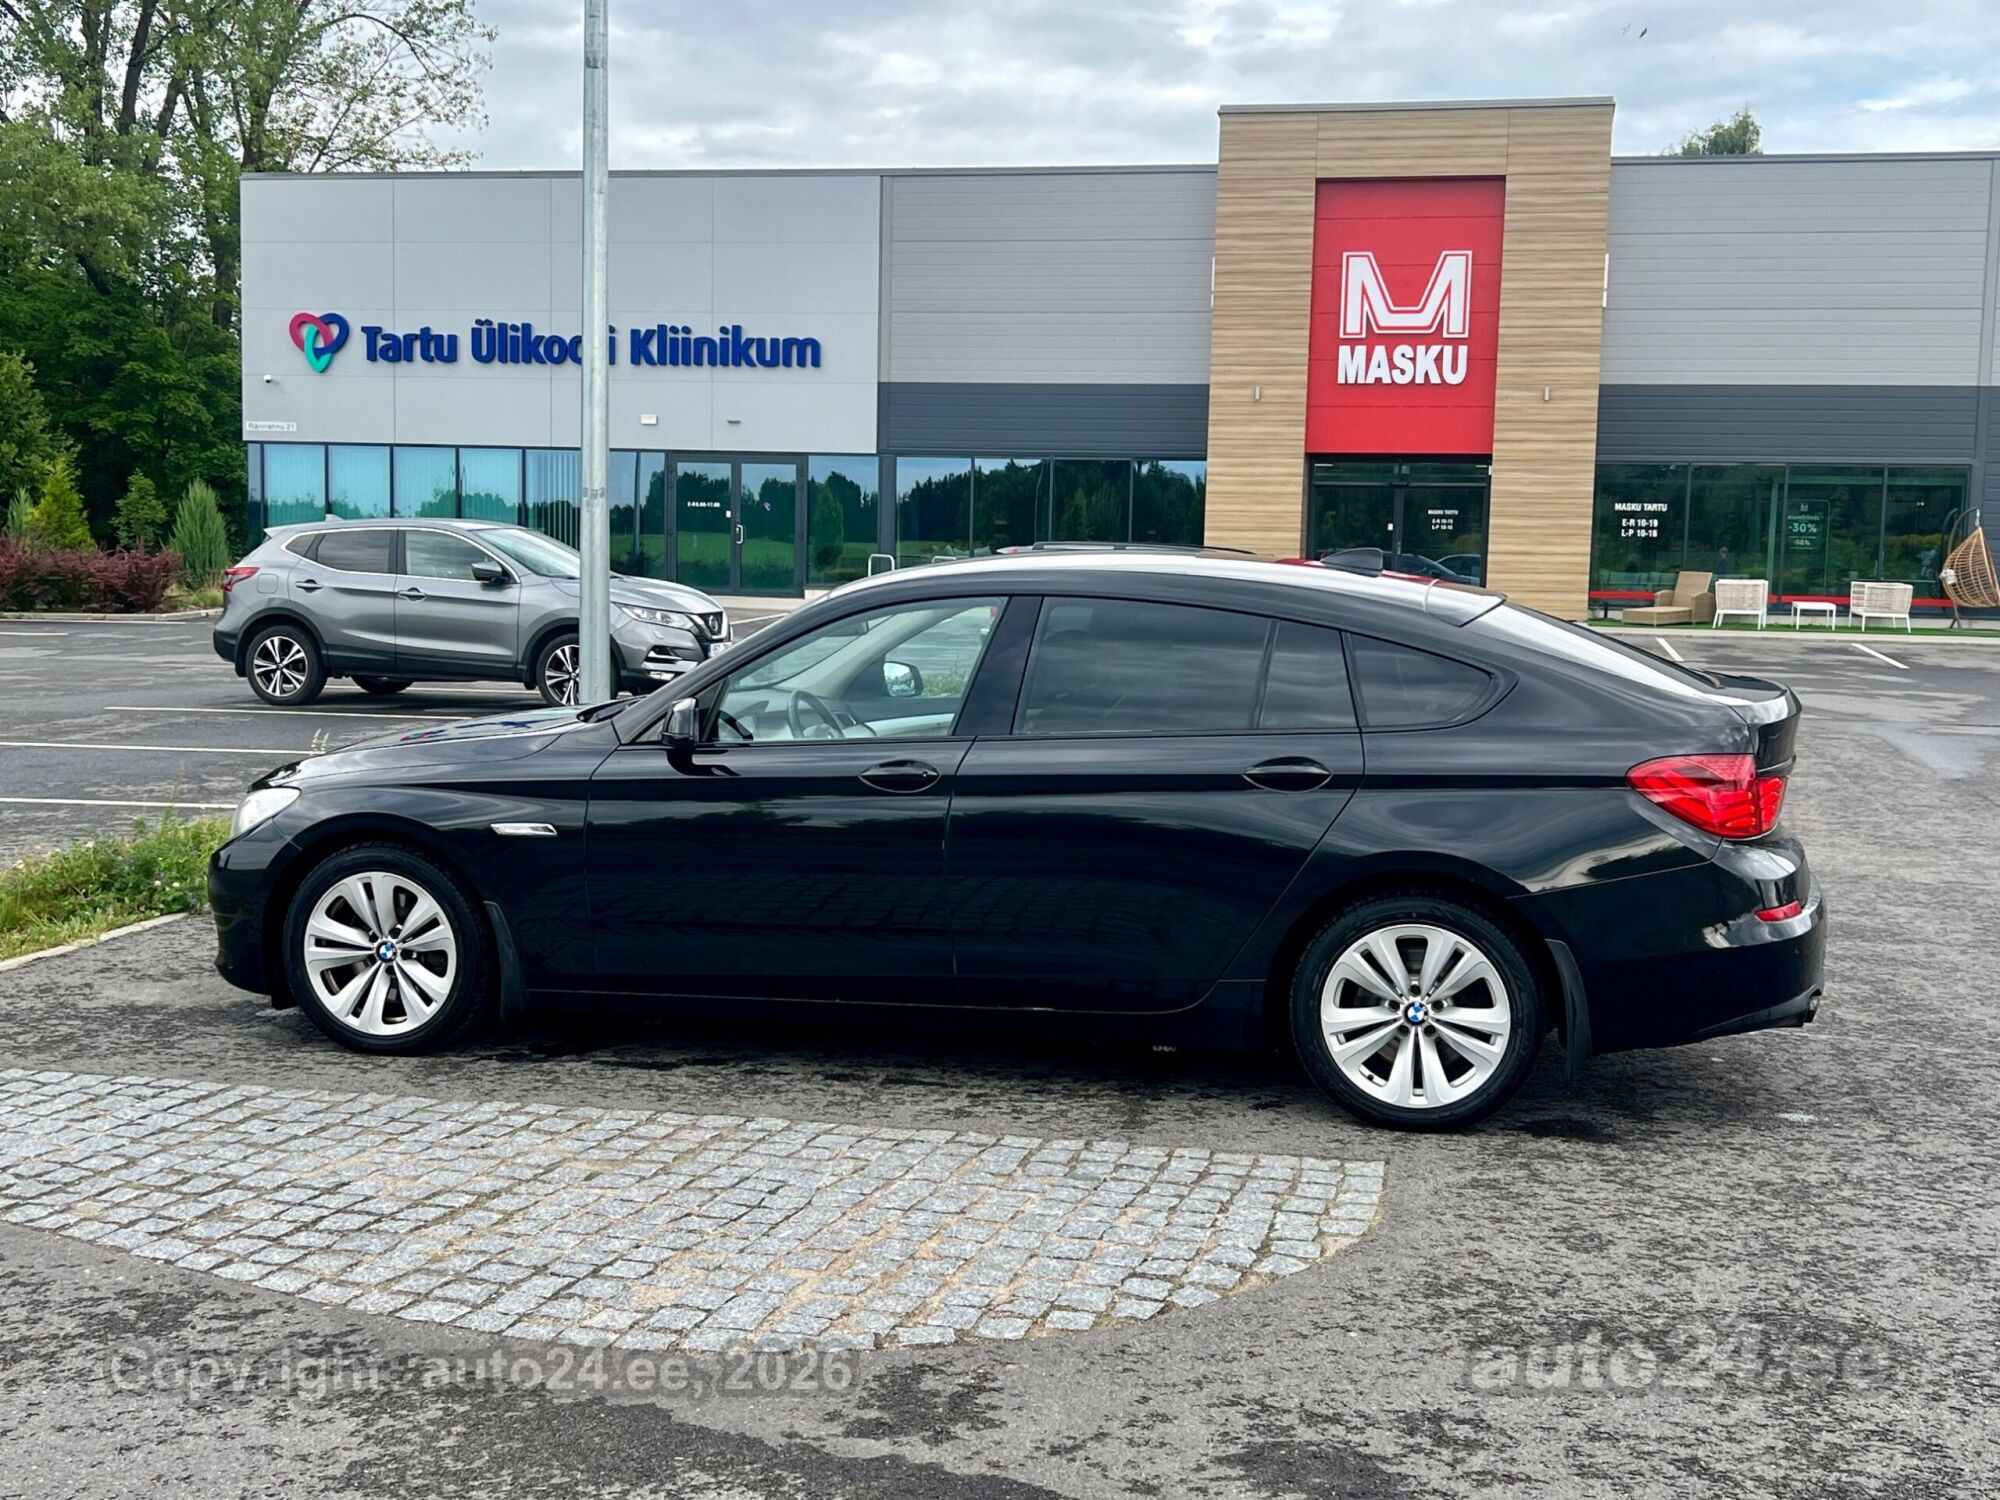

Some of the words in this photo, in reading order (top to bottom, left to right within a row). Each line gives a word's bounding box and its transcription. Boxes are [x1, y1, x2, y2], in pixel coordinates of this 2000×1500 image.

[361, 325, 458, 363] Tartu
[471, 318, 616, 366] Ülikooi
[630, 324, 821, 368] Kliinikum
[1337, 344, 1468, 385] MASKU
[1614, 502, 1642, 512] MASKU
[1643, 503, 1668, 512] TARTU
[1621, 518, 1635, 527] E-R
[1637, 518, 1658, 528] 10-19
[1621, 528, 1635, 537] L-P
